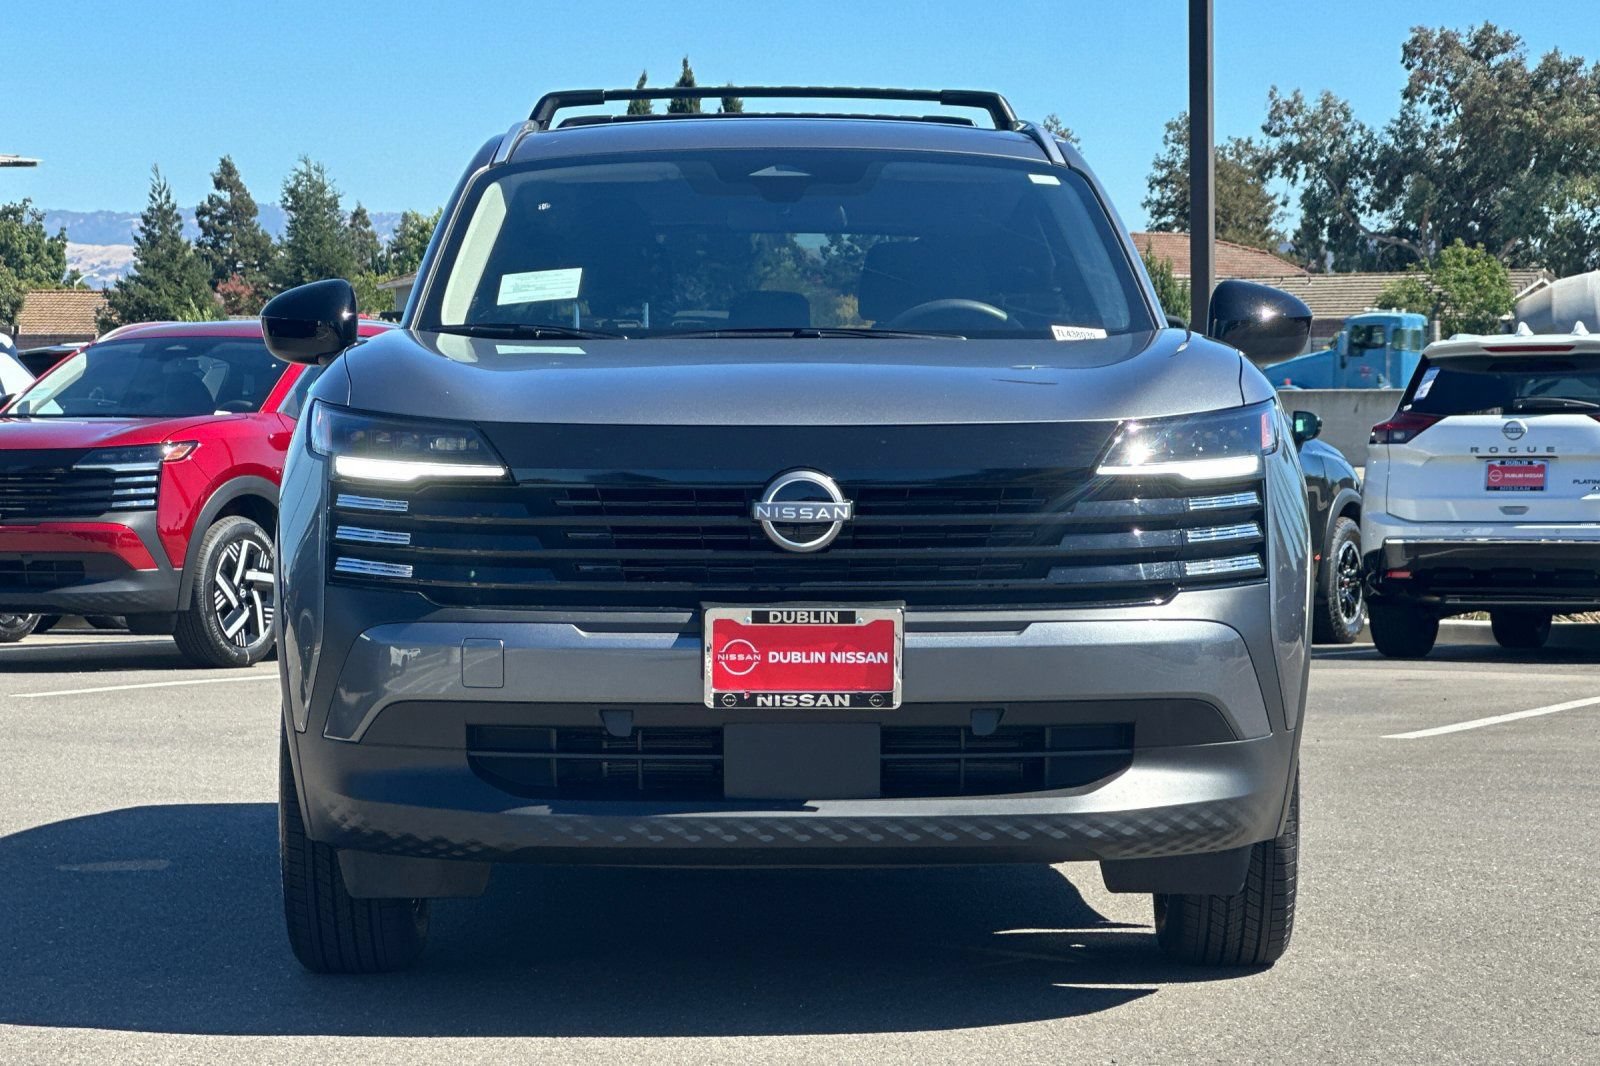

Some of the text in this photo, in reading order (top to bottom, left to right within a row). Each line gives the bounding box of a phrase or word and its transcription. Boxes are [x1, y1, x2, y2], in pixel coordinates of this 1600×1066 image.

[756, 506, 848, 519] NISSAN
[769, 611, 839, 624] DUBLIN
[768, 652, 888, 664] DUBLIN NISSAN
[756, 694, 850, 707] NISSAN
